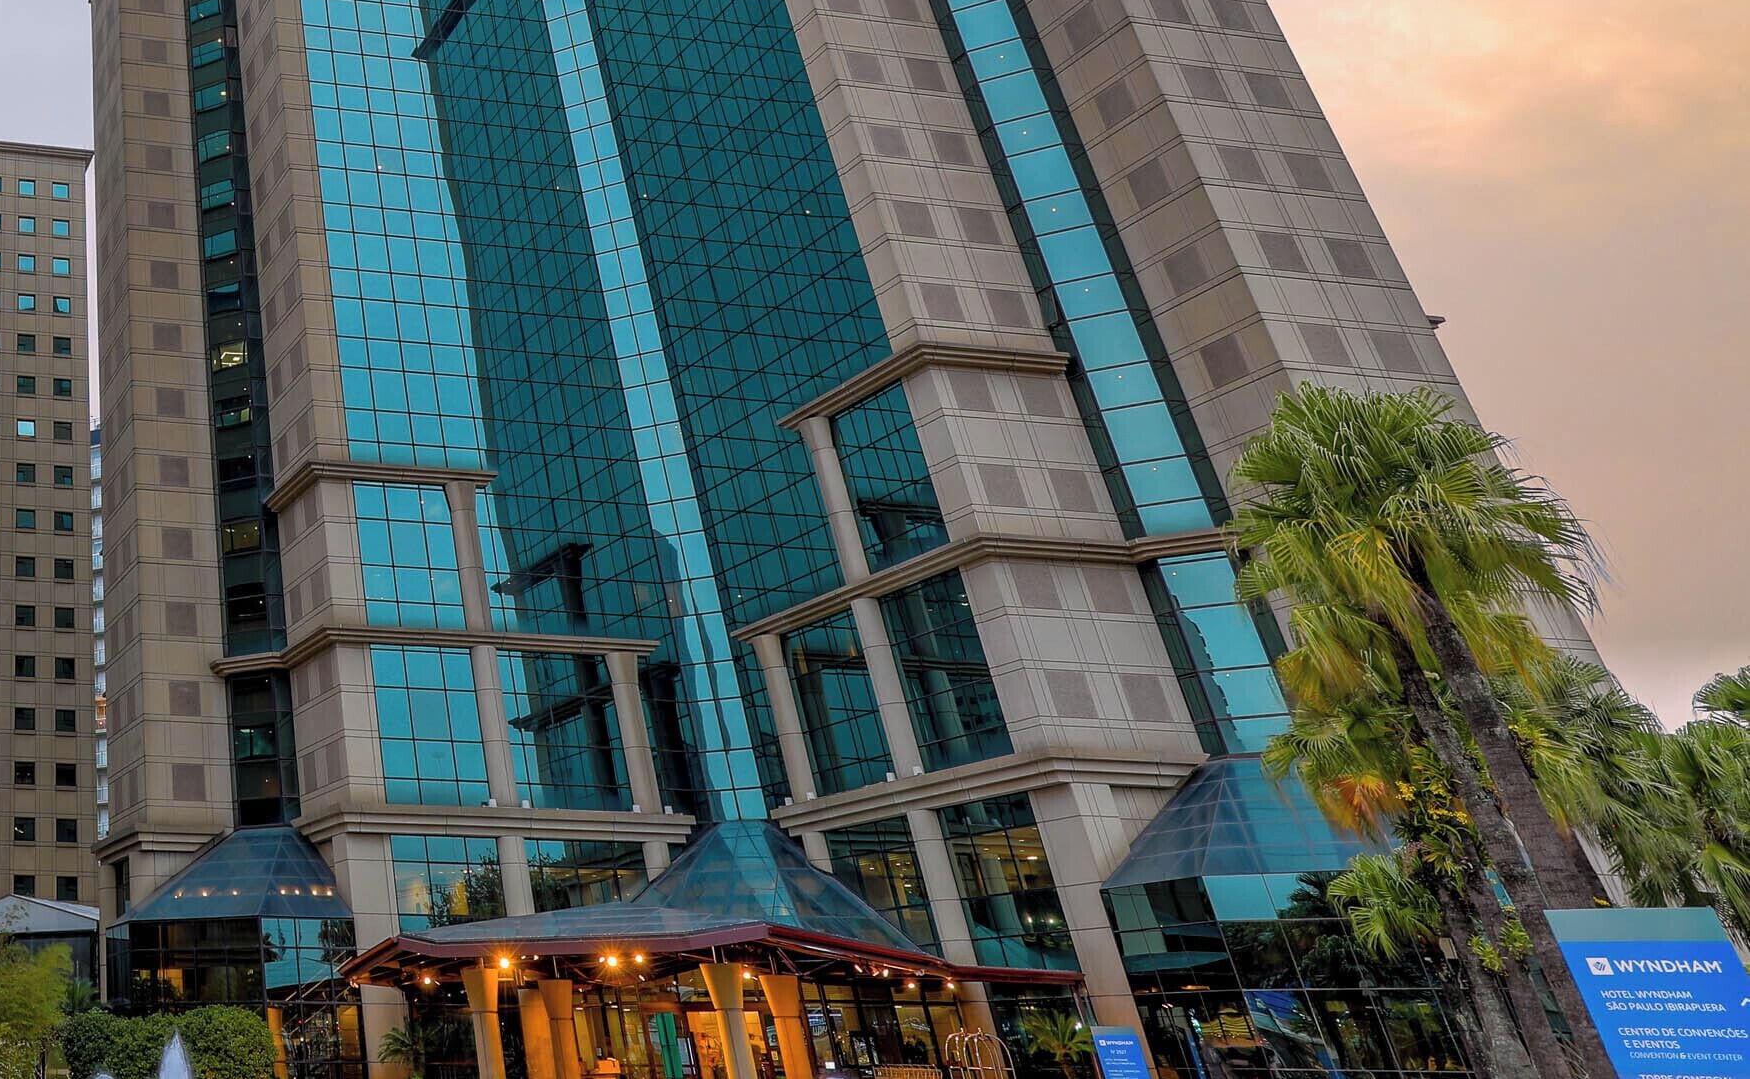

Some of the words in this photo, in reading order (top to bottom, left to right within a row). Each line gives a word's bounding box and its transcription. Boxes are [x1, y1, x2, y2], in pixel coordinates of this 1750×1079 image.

[1613, 960, 1722, 973] WYNDHAM
[1601, 990, 1634, 999] HOTEL
[1635, 991, 1692, 999] WYNDHAM
[1605, 1001, 1627, 1011] SÃO
[1630, 1003, 1663, 1011] PAULO
[1664, 1003, 1726, 1012] IBIRAPUERA
[1618, 1027, 1660, 1037] CENTRO
[1662, 1028, 1676, 1037] DE
[1678, 1027, 1749, 1039] CONVENÇÕES
[1623, 1040, 1631, 1048] E
[1633, 1040, 1680, 1049] EVENTOS
[1630, 1051, 1680, 1060] CONVENTION
[1680, 1052, 1687, 1060] &
[1687, 1052, 1712, 1060] EVENT
[1713, 1053, 1743, 1061] CENTER
